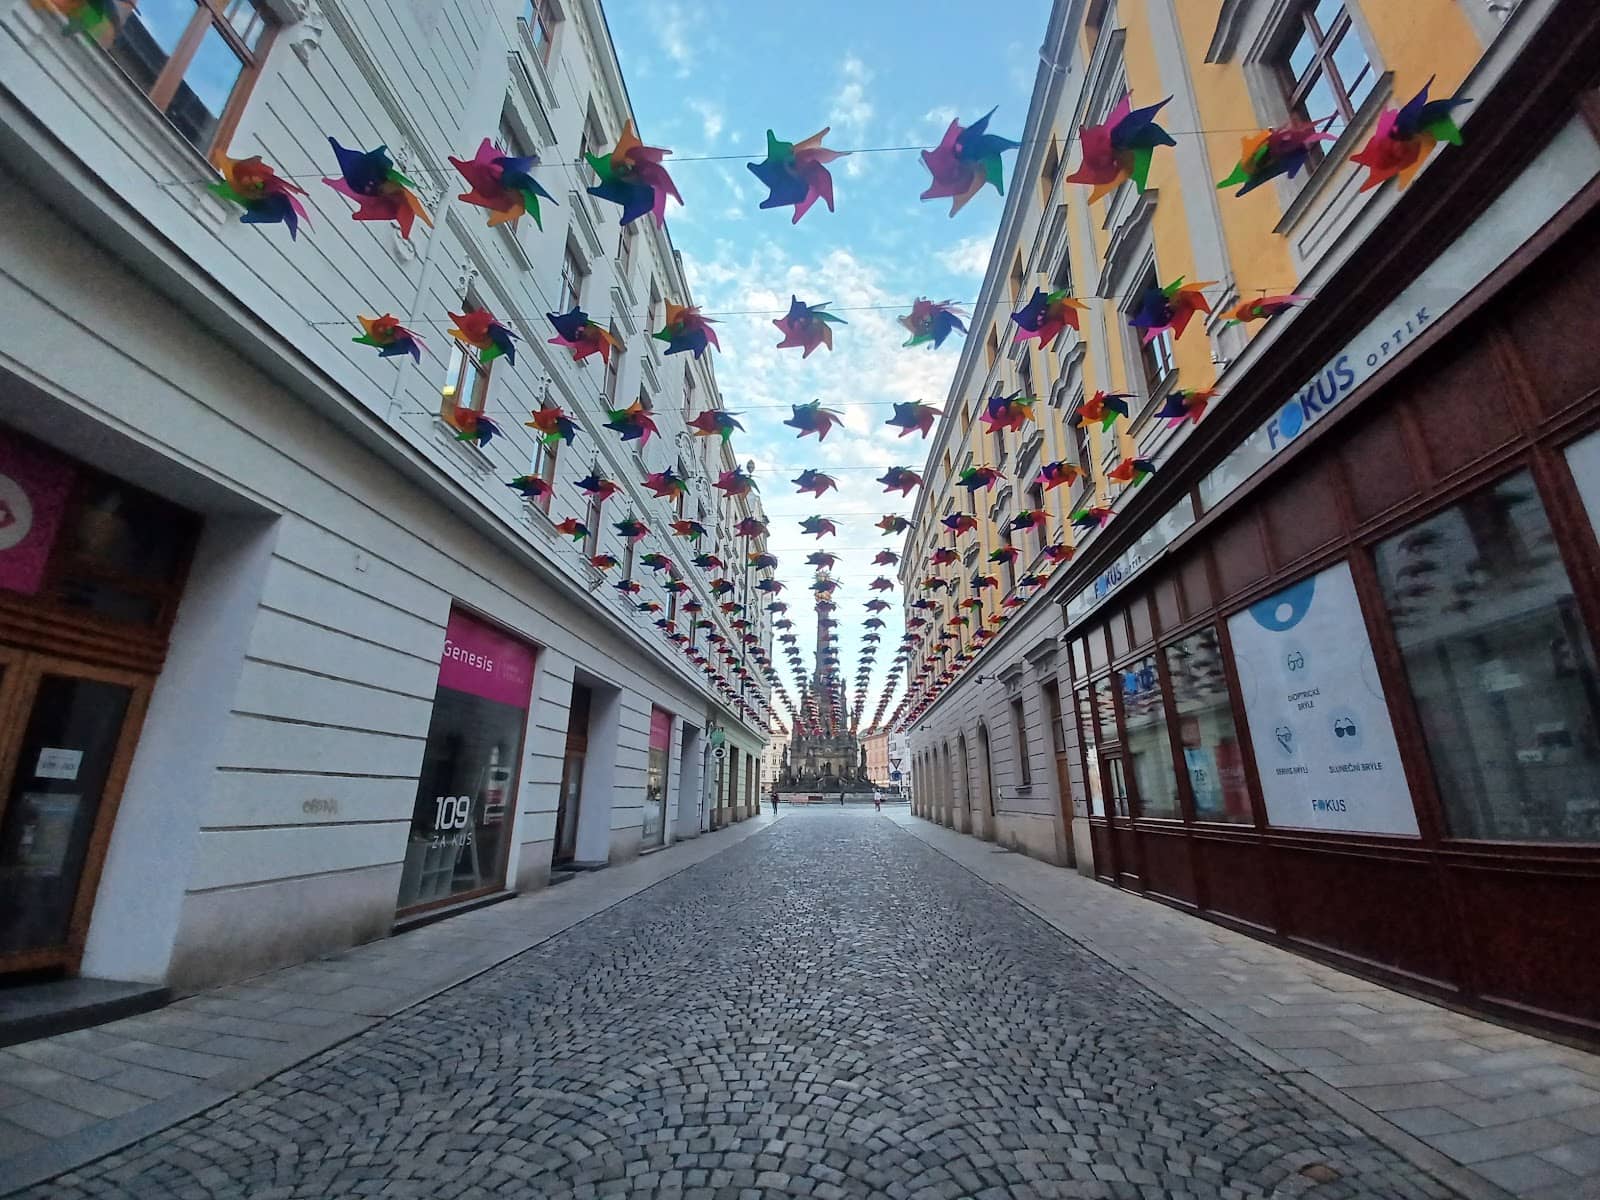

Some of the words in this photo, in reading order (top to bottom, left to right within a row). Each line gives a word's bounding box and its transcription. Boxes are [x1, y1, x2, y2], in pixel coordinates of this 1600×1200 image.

[1267, 356, 1354, 450] FOKUS
[1366, 307, 1430, 367] OPTIK
[1094, 562, 1122, 599] FOKUS
[443, 640, 493, 672] Genesis
[434, 796, 470, 830] 109
[1311, 799, 1346, 812] FOKUS
[432, 835, 446, 848] ZA
